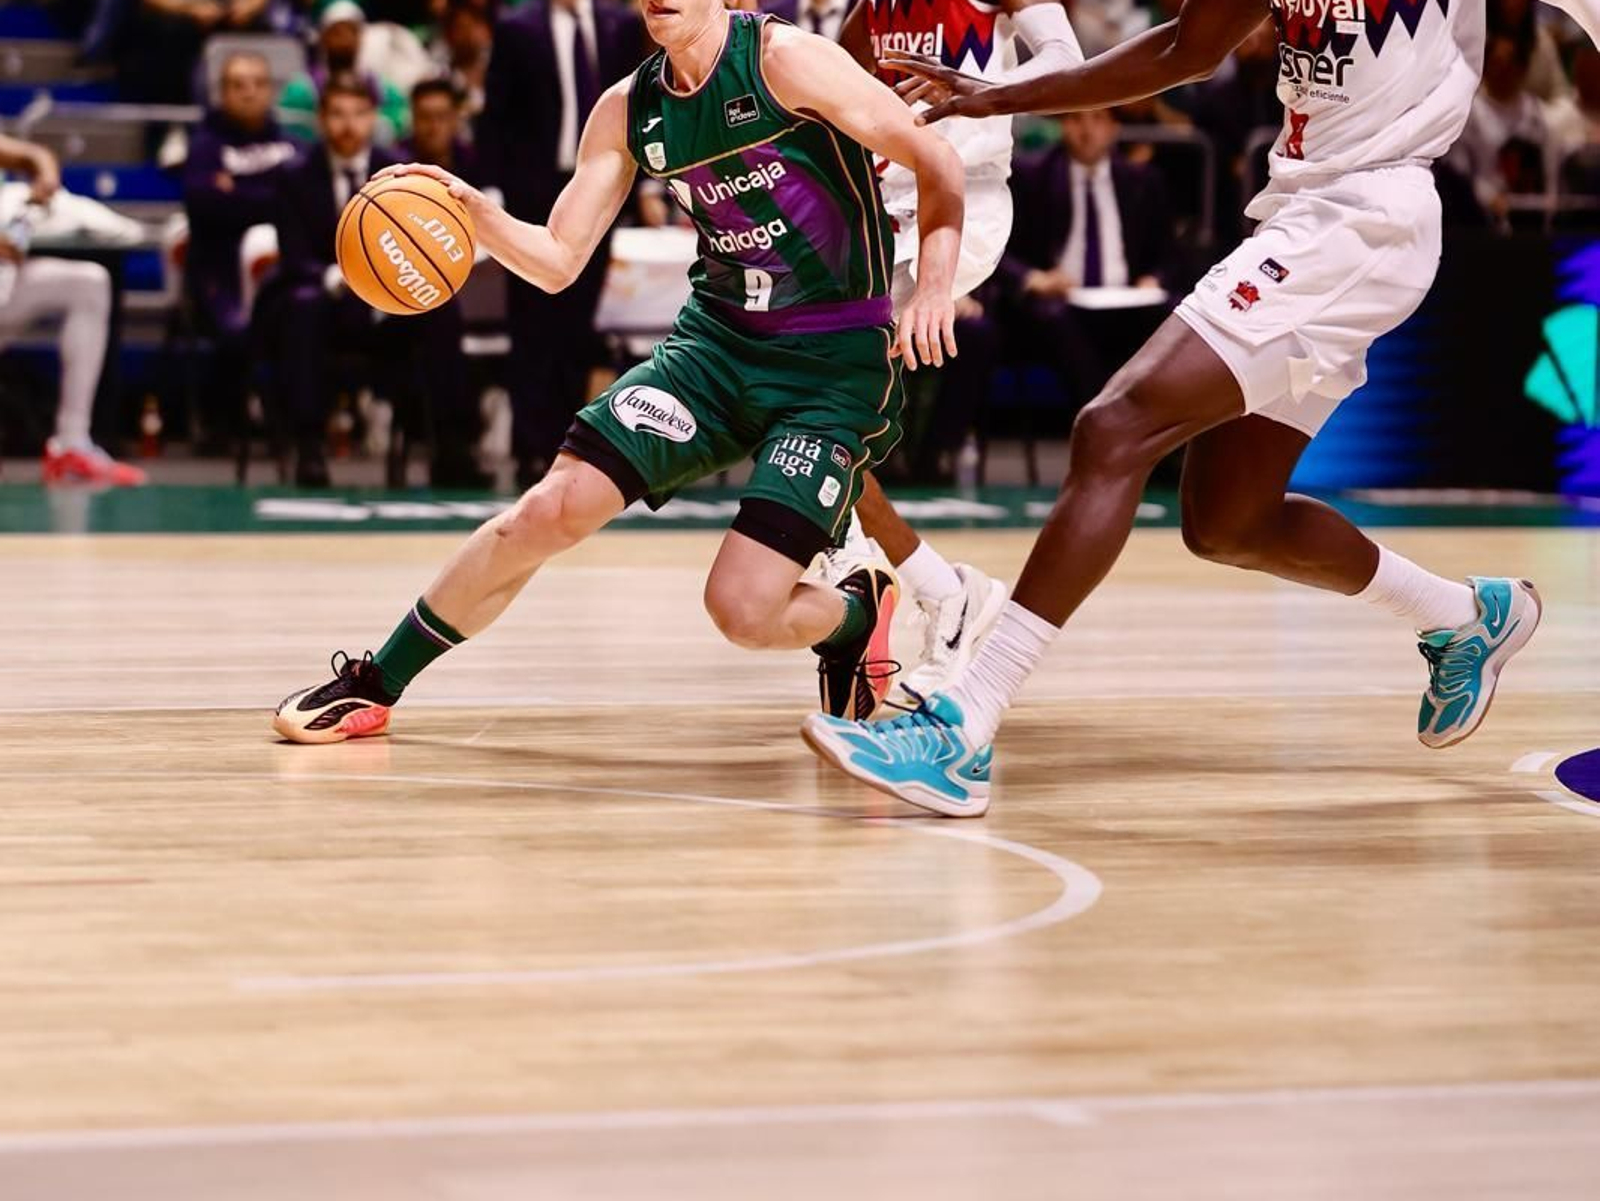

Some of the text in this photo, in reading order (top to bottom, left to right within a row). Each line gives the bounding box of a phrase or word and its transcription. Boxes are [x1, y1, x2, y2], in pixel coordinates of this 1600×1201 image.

[1280, 45, 1354, 87] sner
[697, 159, 787, 205] Unicaja
[378, 229, 441, 307] Wilson
[768, 443, 814, 478] laga
